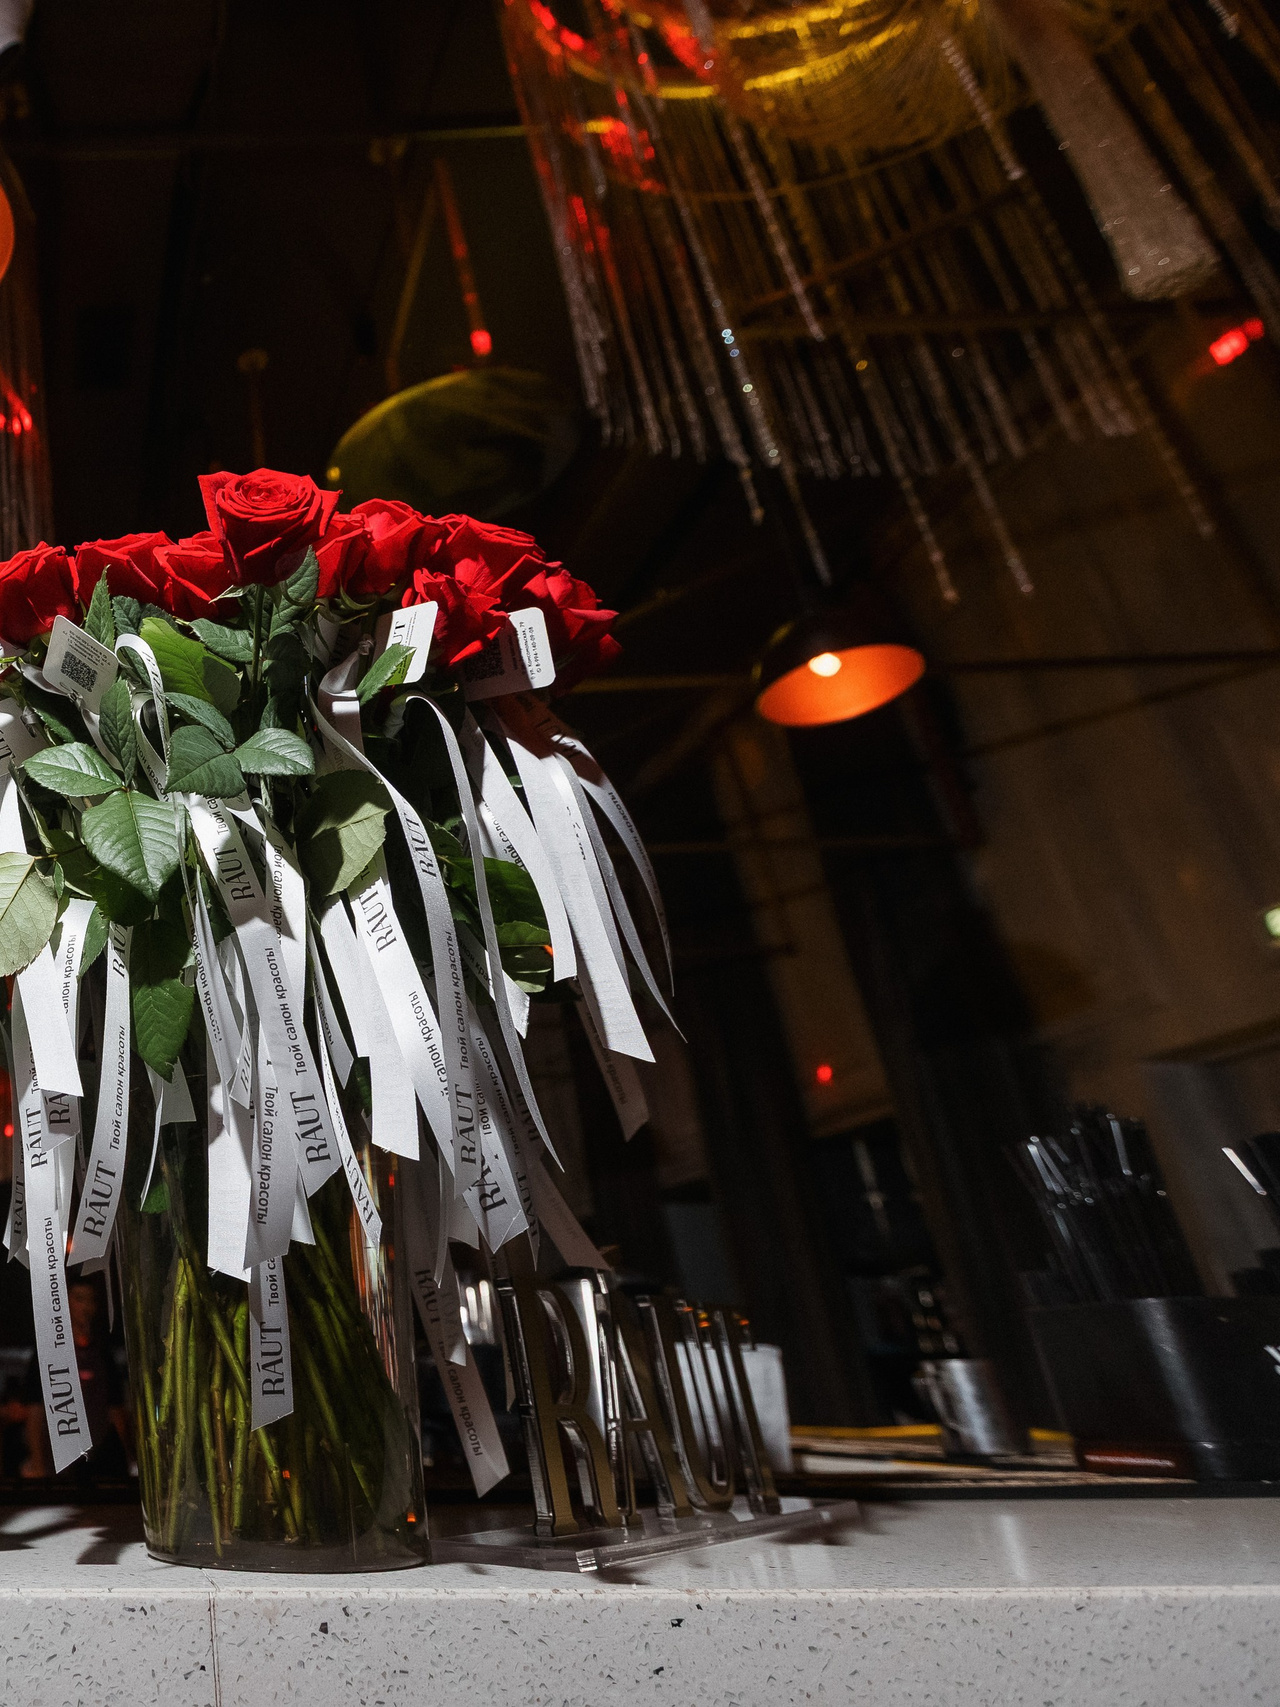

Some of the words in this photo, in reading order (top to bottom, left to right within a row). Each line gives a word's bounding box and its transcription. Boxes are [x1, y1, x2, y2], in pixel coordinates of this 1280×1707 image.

[274, 869, 283, 905] салон
[64, 934, 77, 979] красоты
[195, 952, 208, 986] салон
[264, 947, 288, 1000] красоты
[446, 931, 461, 989] красоты
[279, 1001, 298, 1042] салон
[408, 991, 434, 1042] красоты
[455, 991, 466, 1033] салон
[117, 1025, 126, 1078] красоты
[287, 1045, 307, 1076] Твой
[457, 1037, 468, 1071] Твой
[475, 1036, 499, 1086] красоты
[114, 1078, 124, 1117] салон
[265, 1085, 278, 1117] Твой
[494, 1087, 511, 1125] салон
[109, 1119, 122, 1151] Твой
[261, 1119, 273, 1161] салон
[256, 1162, 272, 1225] красоты
[43, 1215, 58, 1271] красоты
[47, 1272, 61, 1312] салон
[268, 1272, 281, 1307] Твой
[54, 1312, 66, 1349] Твой
[447, 1366, 466, 1404] салон
[458, 1403, 484, 1457] красоты
